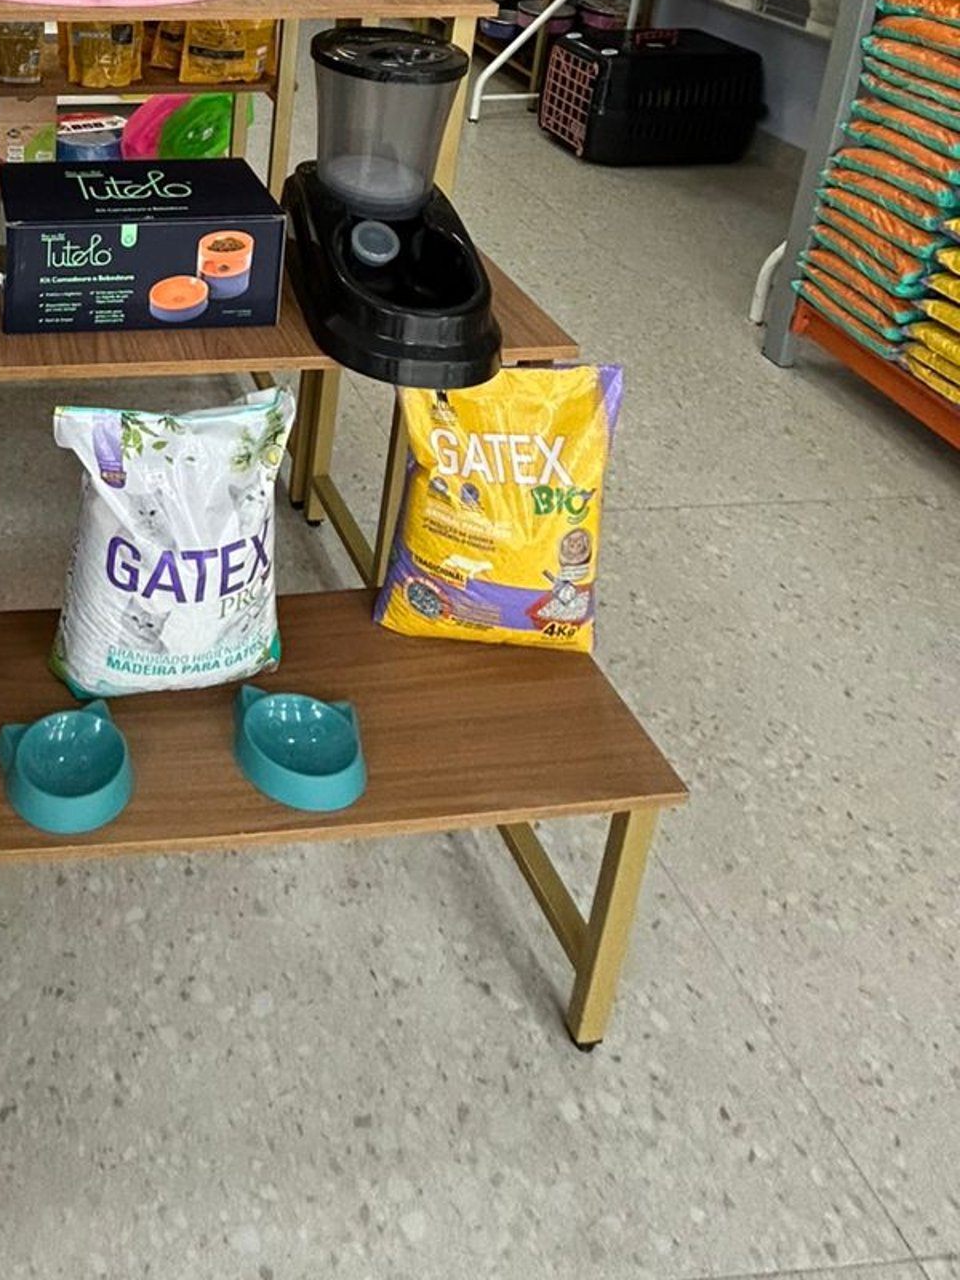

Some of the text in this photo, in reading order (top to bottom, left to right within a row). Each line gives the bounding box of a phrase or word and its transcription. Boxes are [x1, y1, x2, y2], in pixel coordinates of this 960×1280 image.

[65, 170, 192, 200] Tutelo
[41, 233, 112, 268] Tutelo
[429, 428, 574, 487] GATEX
[106, 518, 271, 604] GATEX
[106, 656, 177, 676] MADEIRA
[182, 662, 221, 674] PARA
